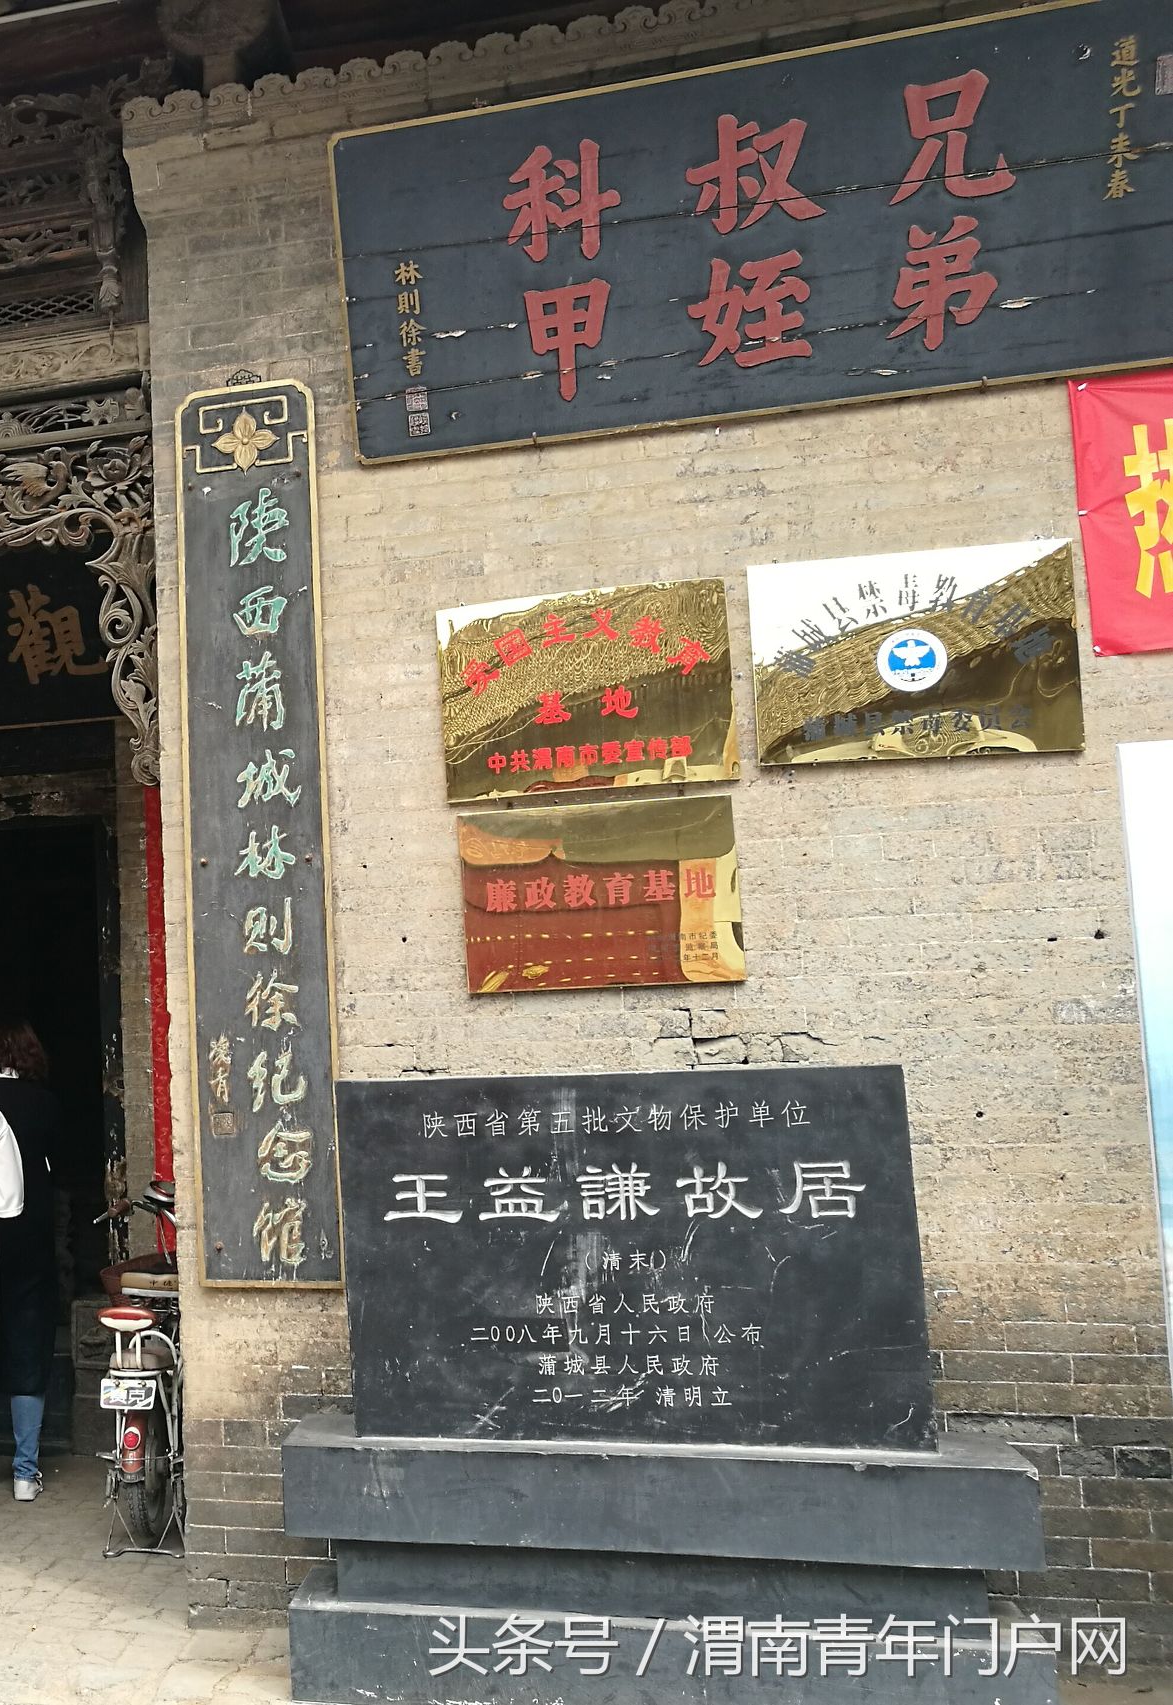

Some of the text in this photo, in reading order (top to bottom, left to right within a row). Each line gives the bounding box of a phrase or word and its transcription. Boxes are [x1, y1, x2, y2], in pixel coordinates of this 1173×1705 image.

[460, 608, 712, 697] 爱国主义教育
[534, 685, 639, 726] 基地
[487, 735, 693, 774] 中共渭南市委宣传部
[485, 868, 717, 914] 廉政教育基地
[422, 1099, 812, 1139] 陕西省第五批文物保护单位
[384, 1159, 867, 1224] 王益謙故居
[535, 1293, 716, 1316] 陕西省人民政府
[538, 1353, 721, 1378] 蒲城县人民政府
